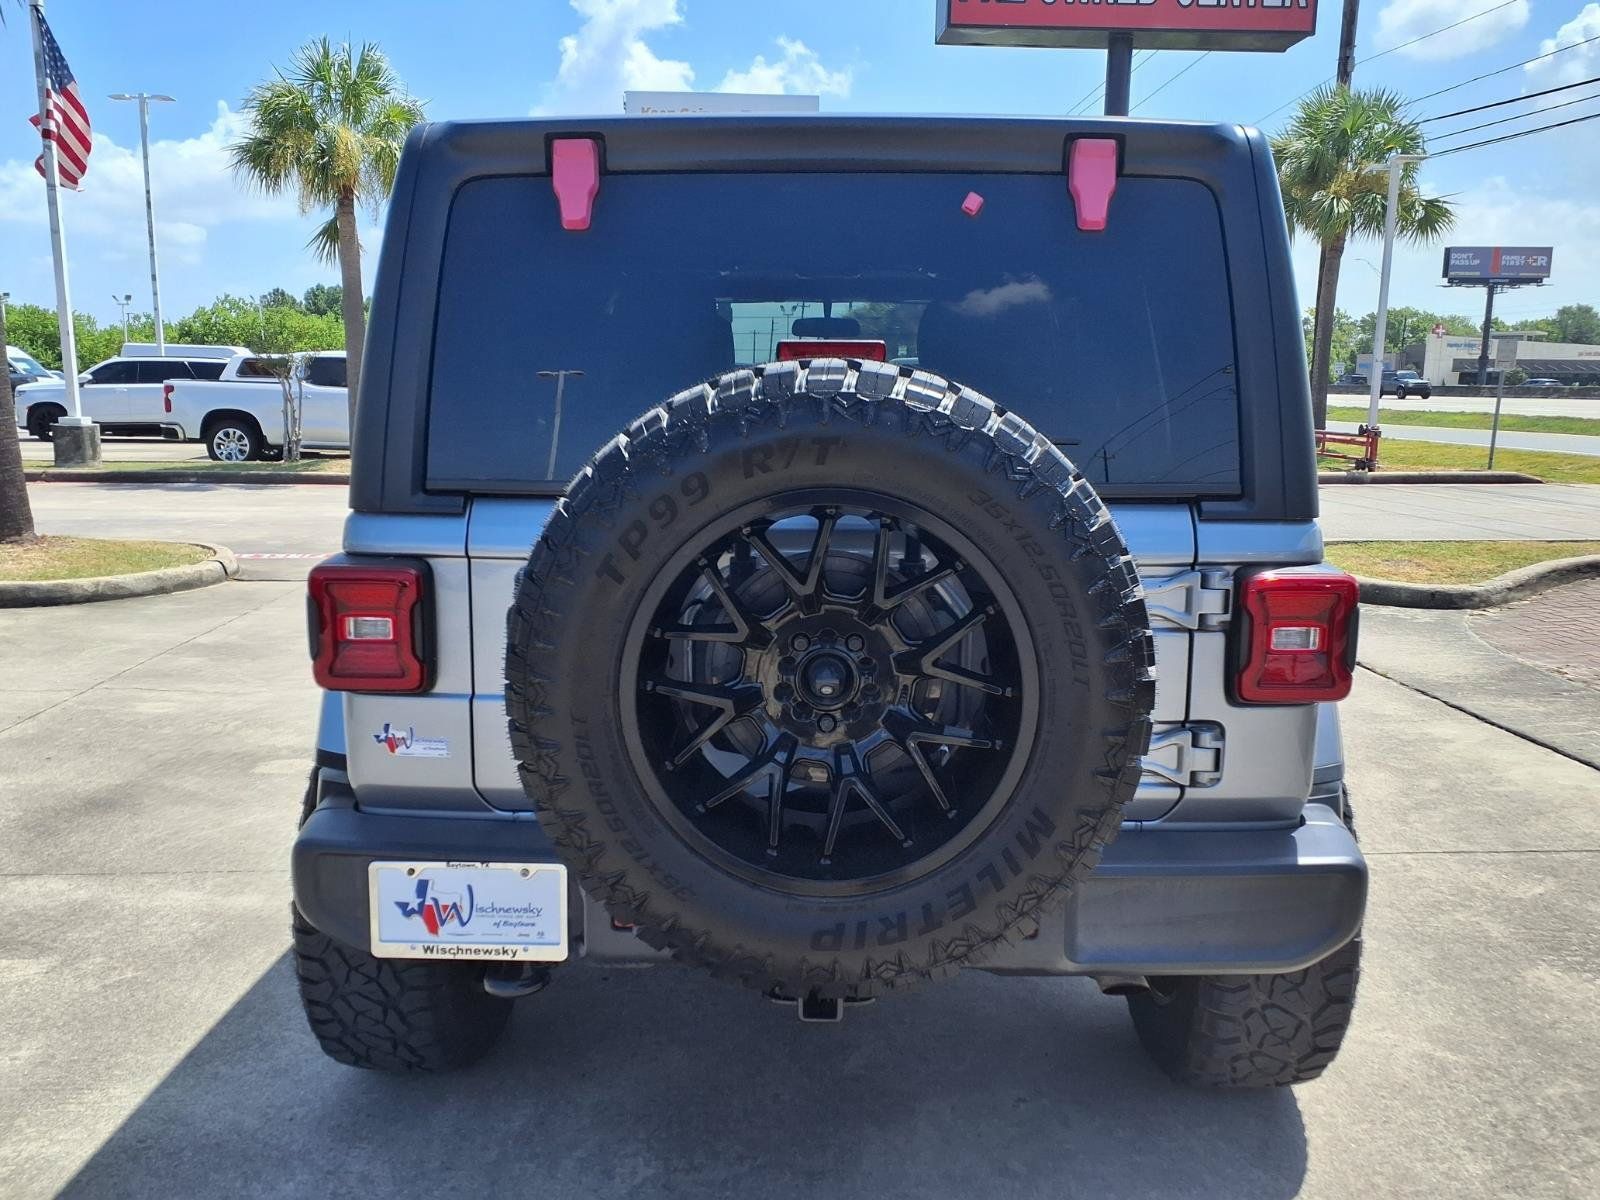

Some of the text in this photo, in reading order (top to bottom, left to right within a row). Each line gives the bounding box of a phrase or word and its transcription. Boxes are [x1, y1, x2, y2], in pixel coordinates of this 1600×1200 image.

[595, 471, 710, 586] TP99
[430, 884, 543, 928] Wischnewsky
[809, 807, 1057, 952] MILETRIP
[422, 944, 519, 958] Wischnewsky
